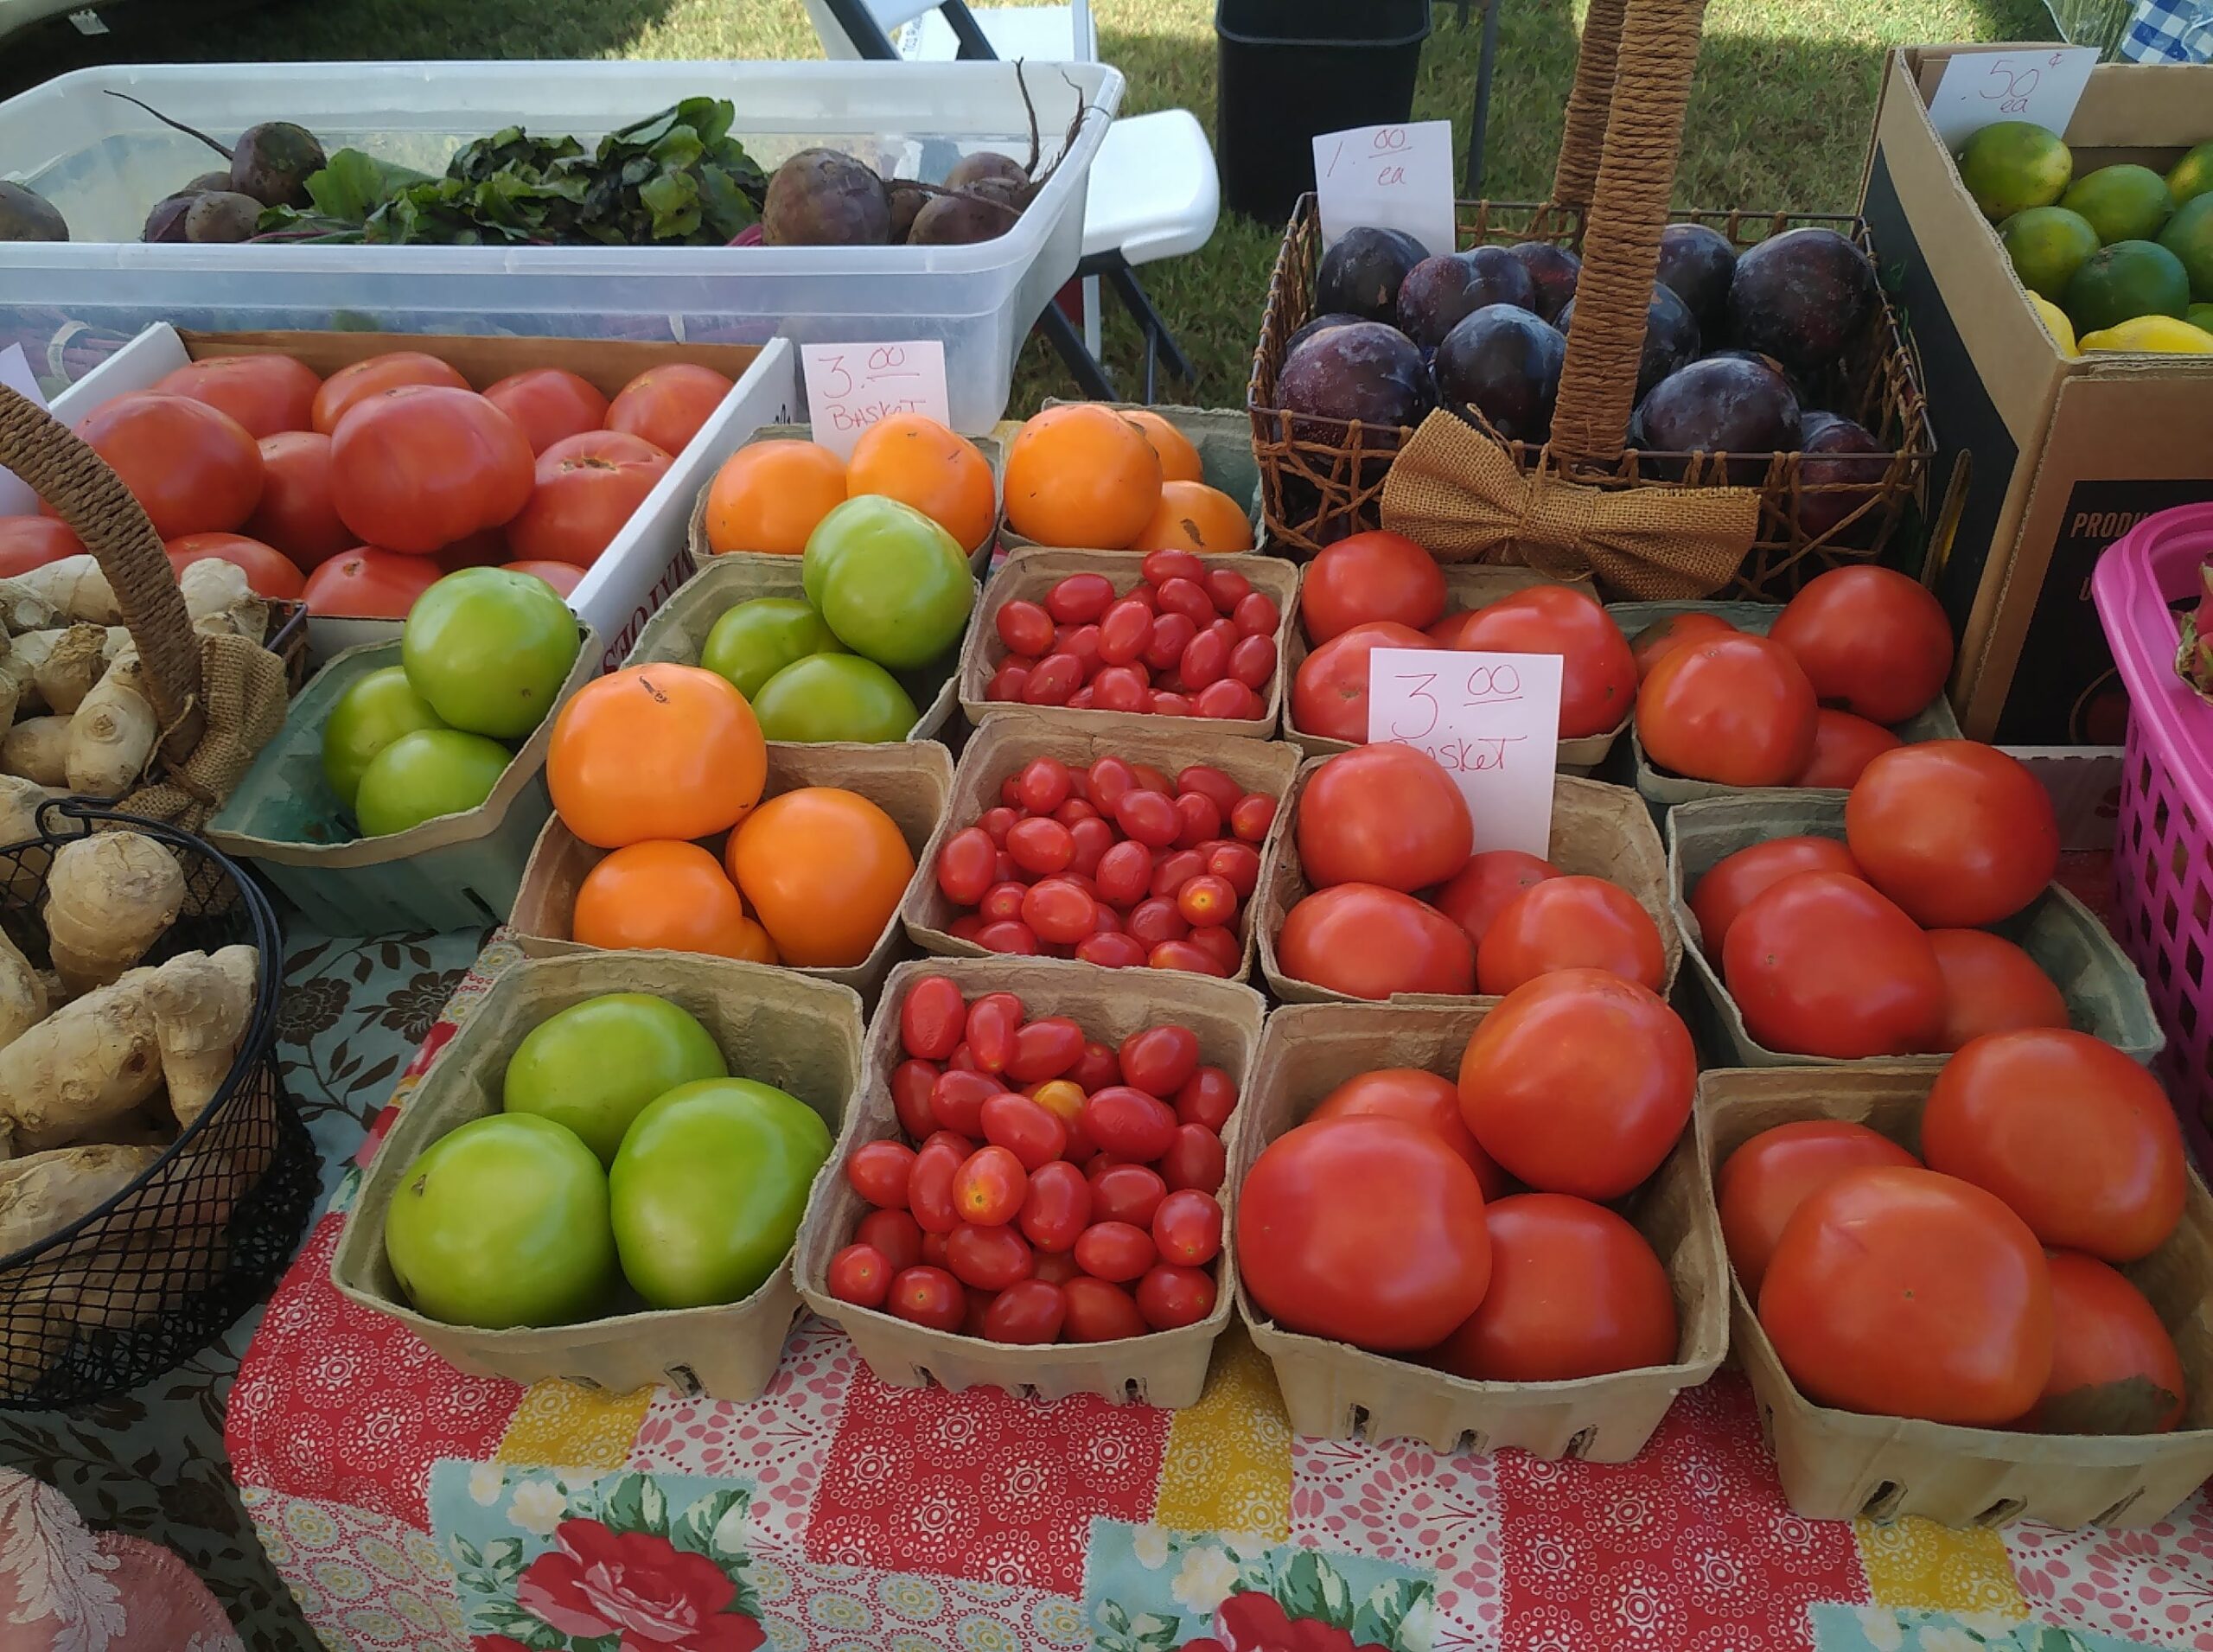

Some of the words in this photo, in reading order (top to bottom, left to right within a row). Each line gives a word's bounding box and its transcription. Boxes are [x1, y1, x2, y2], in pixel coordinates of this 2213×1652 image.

[1999, 98, 2028, 114] ea
[1377, 166, 1406, 187] ea
[818, 347, 921, 399] 3.00
[2070, 512, 2150, 538] PROD
[1391, 664, 1524, 740] 3.00
